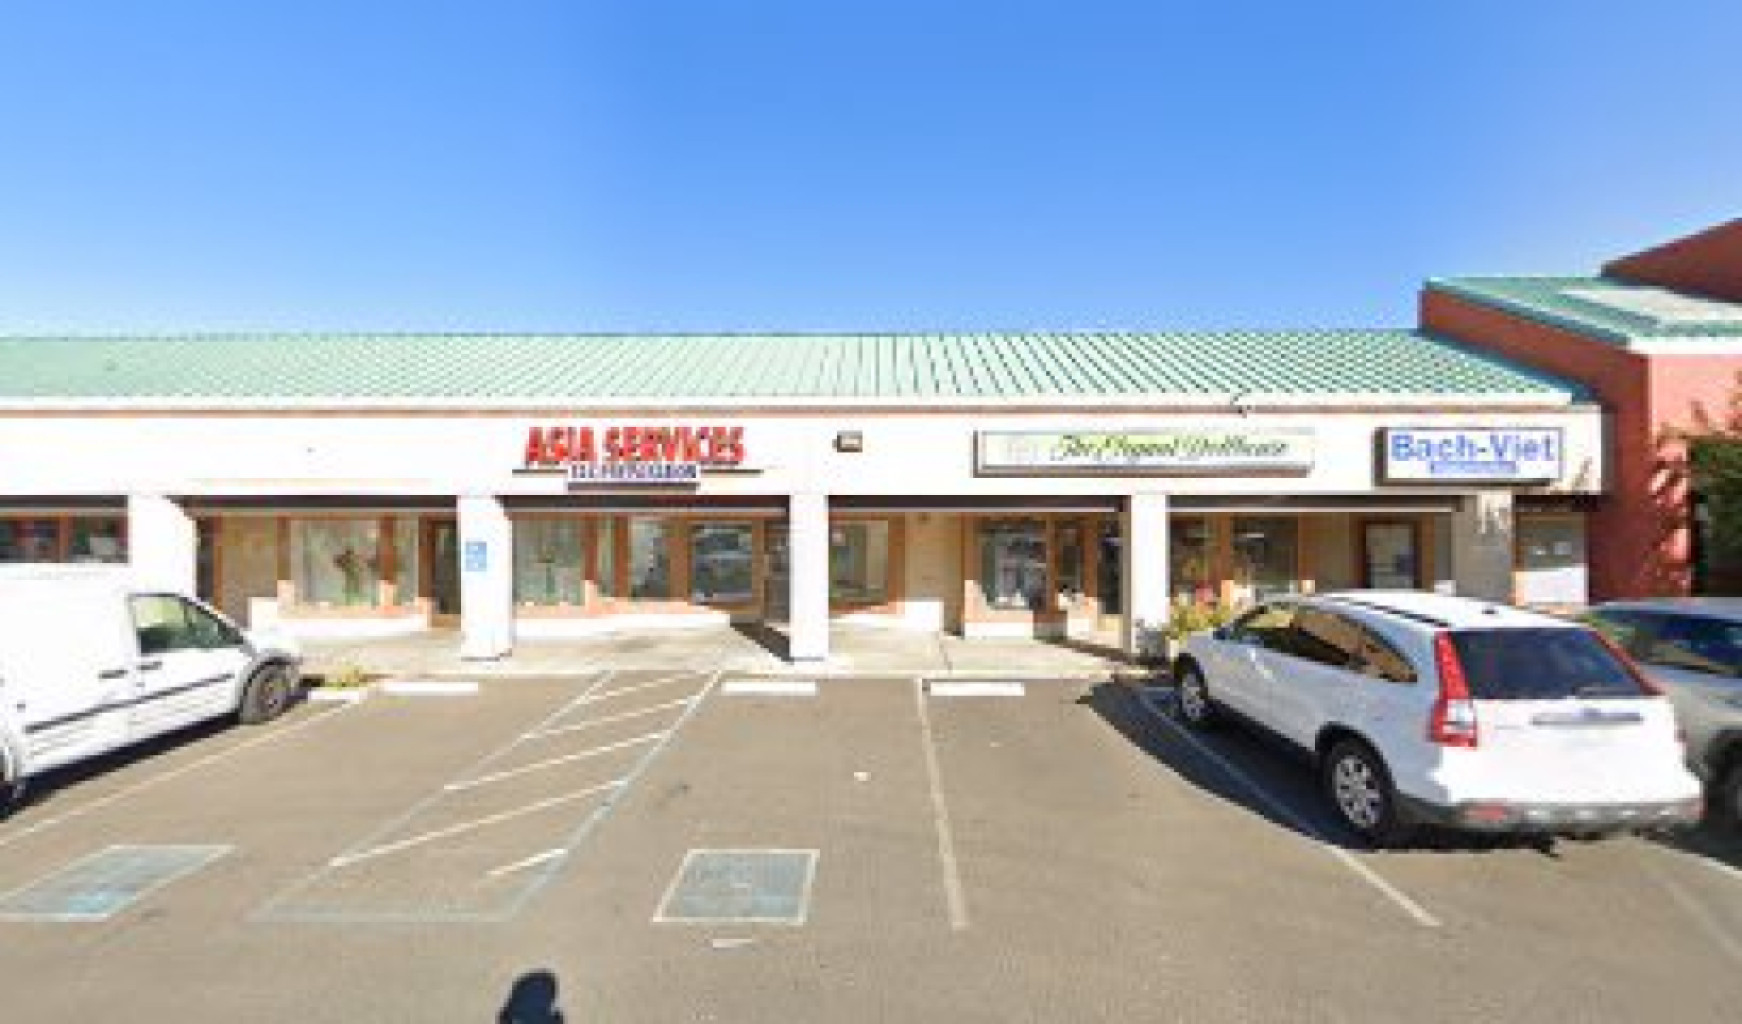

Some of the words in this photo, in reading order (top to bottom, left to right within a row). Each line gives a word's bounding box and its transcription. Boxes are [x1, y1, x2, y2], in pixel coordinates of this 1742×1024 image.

[523, 426, 597, 463] ASIA
[603, 426, 746, 463] SERVICES
[1391, 434, 1556, 462] Bach-Viet
